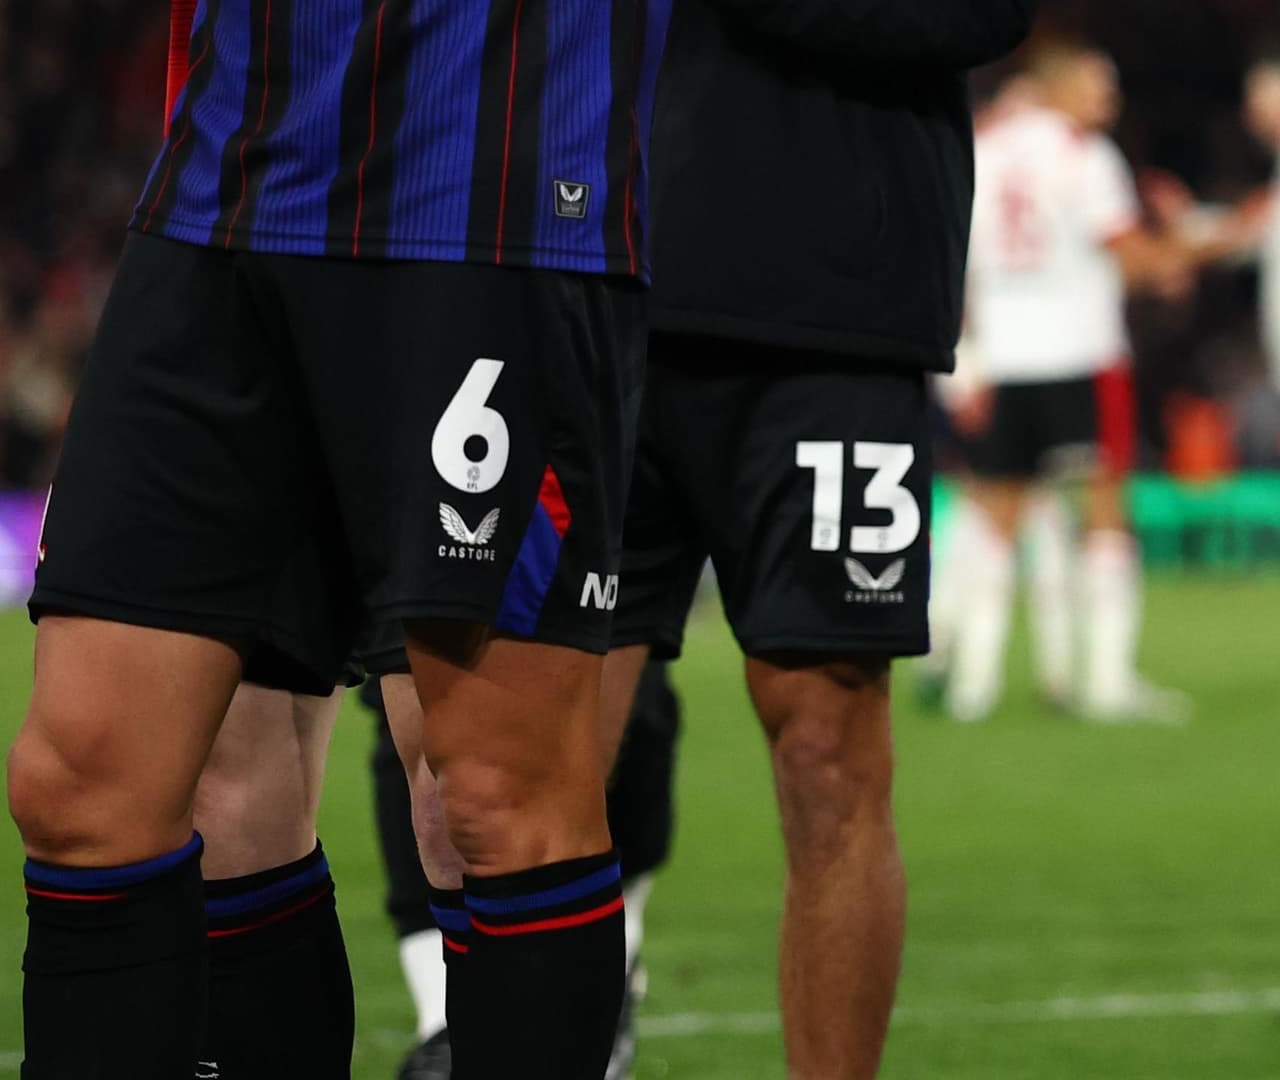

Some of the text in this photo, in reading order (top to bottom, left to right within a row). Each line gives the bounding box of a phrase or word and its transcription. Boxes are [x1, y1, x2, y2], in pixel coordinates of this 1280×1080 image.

[431, 357, 511, 495] 6
[438, 544, 496, 562] CASTORE
[795, 440, 922, 554] 13
